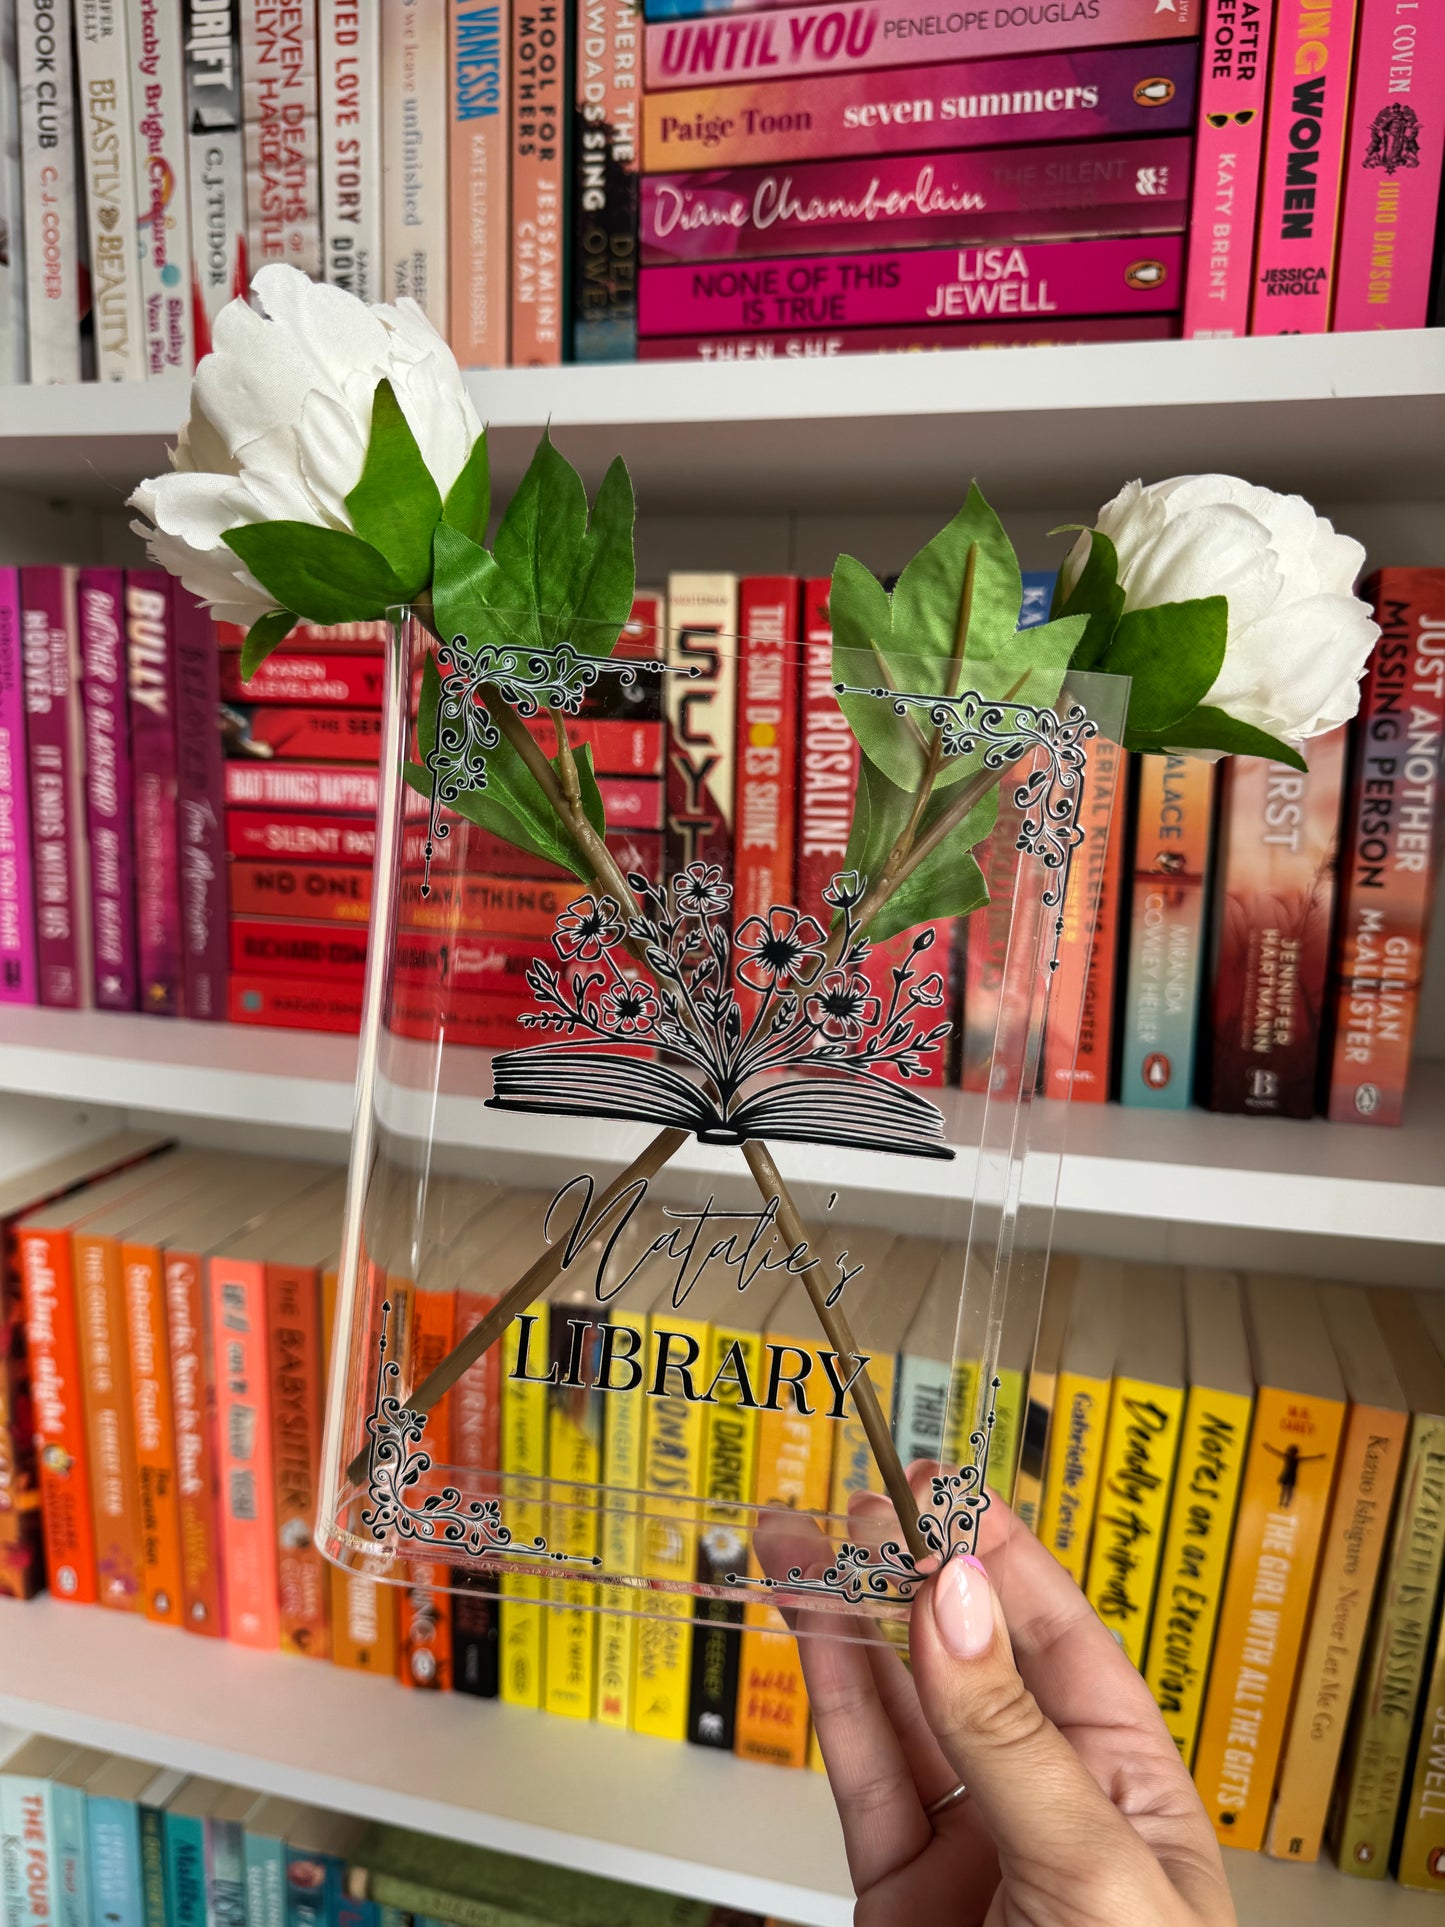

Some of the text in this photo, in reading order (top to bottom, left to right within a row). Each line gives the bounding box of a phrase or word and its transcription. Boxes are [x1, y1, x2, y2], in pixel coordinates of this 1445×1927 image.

[34, 0, 59, 149] BOOK CLUB
[280, 0, 303, 89] SEVEN
[455, 6, 501, 122] VANESSA
[517, 15, 537, 158] MOTHERS
[660, 0, 1100, 78] UNTIL YOU PENELOPE DOUGLAS
[1236, 3, 1260, 82] AFTER
[1387, 23, 1418, 95] COVEN
[139, 83, 163, 158] Bright
[334, 57, 361, 128] LOVE
[402, 14, 424, 228] we leave unfinished
[611, 101, 636, 163] THE
[660, 107, 813, 149] Paige Toon
[842, 84, 1099, 130] seven summers
[256, 78, 285, 258] HARDCASTLE
[281, 104, 308, 224] DEATHS
[335, 138, 362, 226] STORY
[581, 131, 607, 213] SING
[653, 184, 750, 237] Diane
[753, 164, 987, 230] Chamberlain
[1052, 158, 1129, 186] SILENT
[1214, 152, 1237, 217] KATY
[1279, 75, 1327, 240] WOMEN
[42, 211, 63, 300] COOPER
[88, 78, 130, 360] BEASTLY BEAUTY
[148, 160, 170, 269] Creatures
[206, 192, 228, 288] TUDOR
[469, 134, 489, 348] KATE ELIZABETH RUSSELL
[516, 220, 538, 304] CHAN
[536, 104, 558, 344] FOR JESSAMINE
[1208, 222, 1233, 303] BRENT
[1367, 180, 1401, 305] JUNO DAWSON
[692, 261, 902, 301] NONE OF THIS
[741, 294, 846, 326] IS TRUE
[926, 280, 1058, 318] JEWELL
[957, 248, 1029, 283] LISA
[1260, 266, 1327, 284] JESSICA
[1266, 282, 1321, 297] KNOLL
[147, 293, 164, 339] Van
[166, 297, 184, 368] Shelby
[23, 610, 52, 715] HOOVER
[125, 586, 168, 715] BULLY
[747, 604, 785, 652] THE
[746, 659, 784, 701] SUN
[803, 709, 857, 860] ROSALINE
[1358, 601, 1410, 890] MISSING PERSON
[1395, 614, 1445, 874] JUST ANOTHER
[35, 744, 69, 940] IT ENDS WITH US
[741, 783, 781, 853] SHINE
[254, 872, 296, 894] NO
[303, 874, 360, 898] ONE
[1138, 893, 1166, 983] COWLEY
[1165, 923, 1191, 1017] MIRANDA
[1343, 907, 1385, 1065] McALLISTER
[1252, 928, 1281, 1053] HARTMANN
[1276, 936, 1301, 1048] JENNIFER
[1377, 936, 1408, 1043] GILLIAN
[543, 1173, 865, 1309] Natalie's
[508, 1313, 872, 1421] LIBRARY
[278, 1325, 311, 1512] BABYSITTER
[1063, 1391, 1095, 1490] Gabrielle
[708, 1420, 747, 1517] DARKER
[1157, 1410, 1236, 1717] Notes on an Execution
[1309, 1433, 1390, 1743] Kazuo Ishiguro Never Let Me Go
[1381, 1450, 1445, 1720] ELIZABETH IS MISSING
[1215, 1510, 1300, 1811] THE GIRL WITH ALL THE GIFTS
[23, 1795, 50, 1918] THE FOUR
